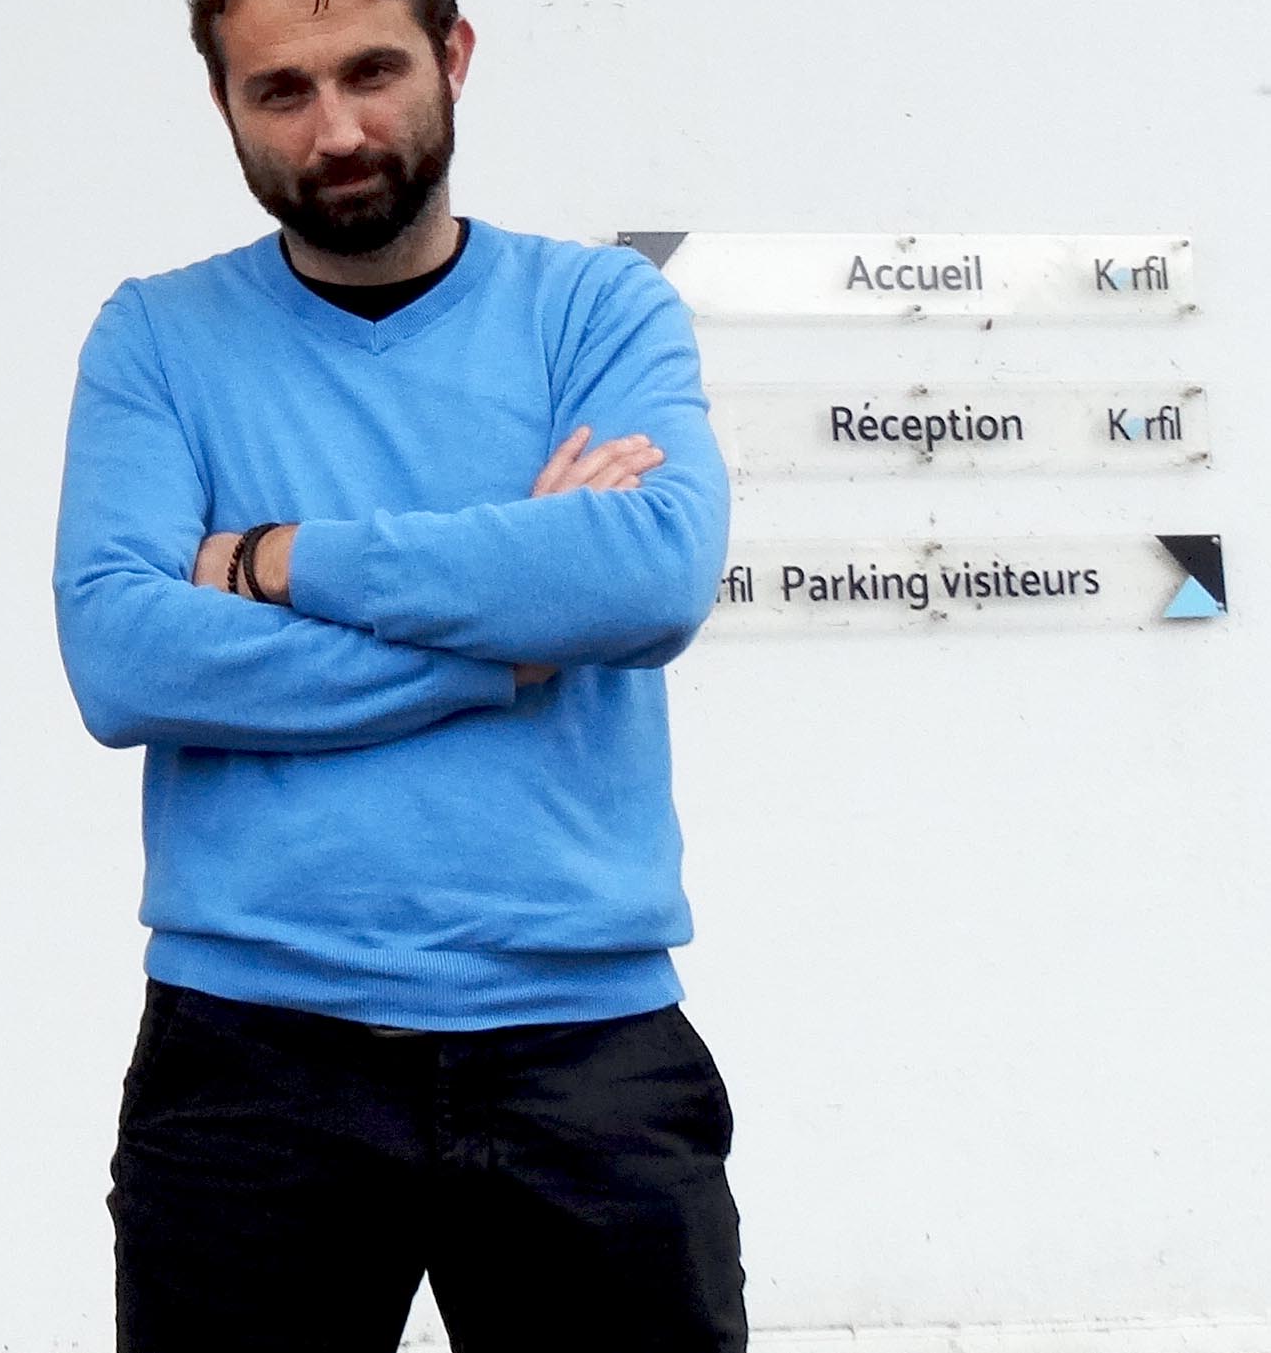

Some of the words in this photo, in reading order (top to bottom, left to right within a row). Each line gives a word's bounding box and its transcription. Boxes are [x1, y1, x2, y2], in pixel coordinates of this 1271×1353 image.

[846, 255, 983, 290] Accueil
[830, 402, 1023, 452] Réception
[781, 563, 929, 610] Parking
[941, 561, 1100, 598] visiteurs
